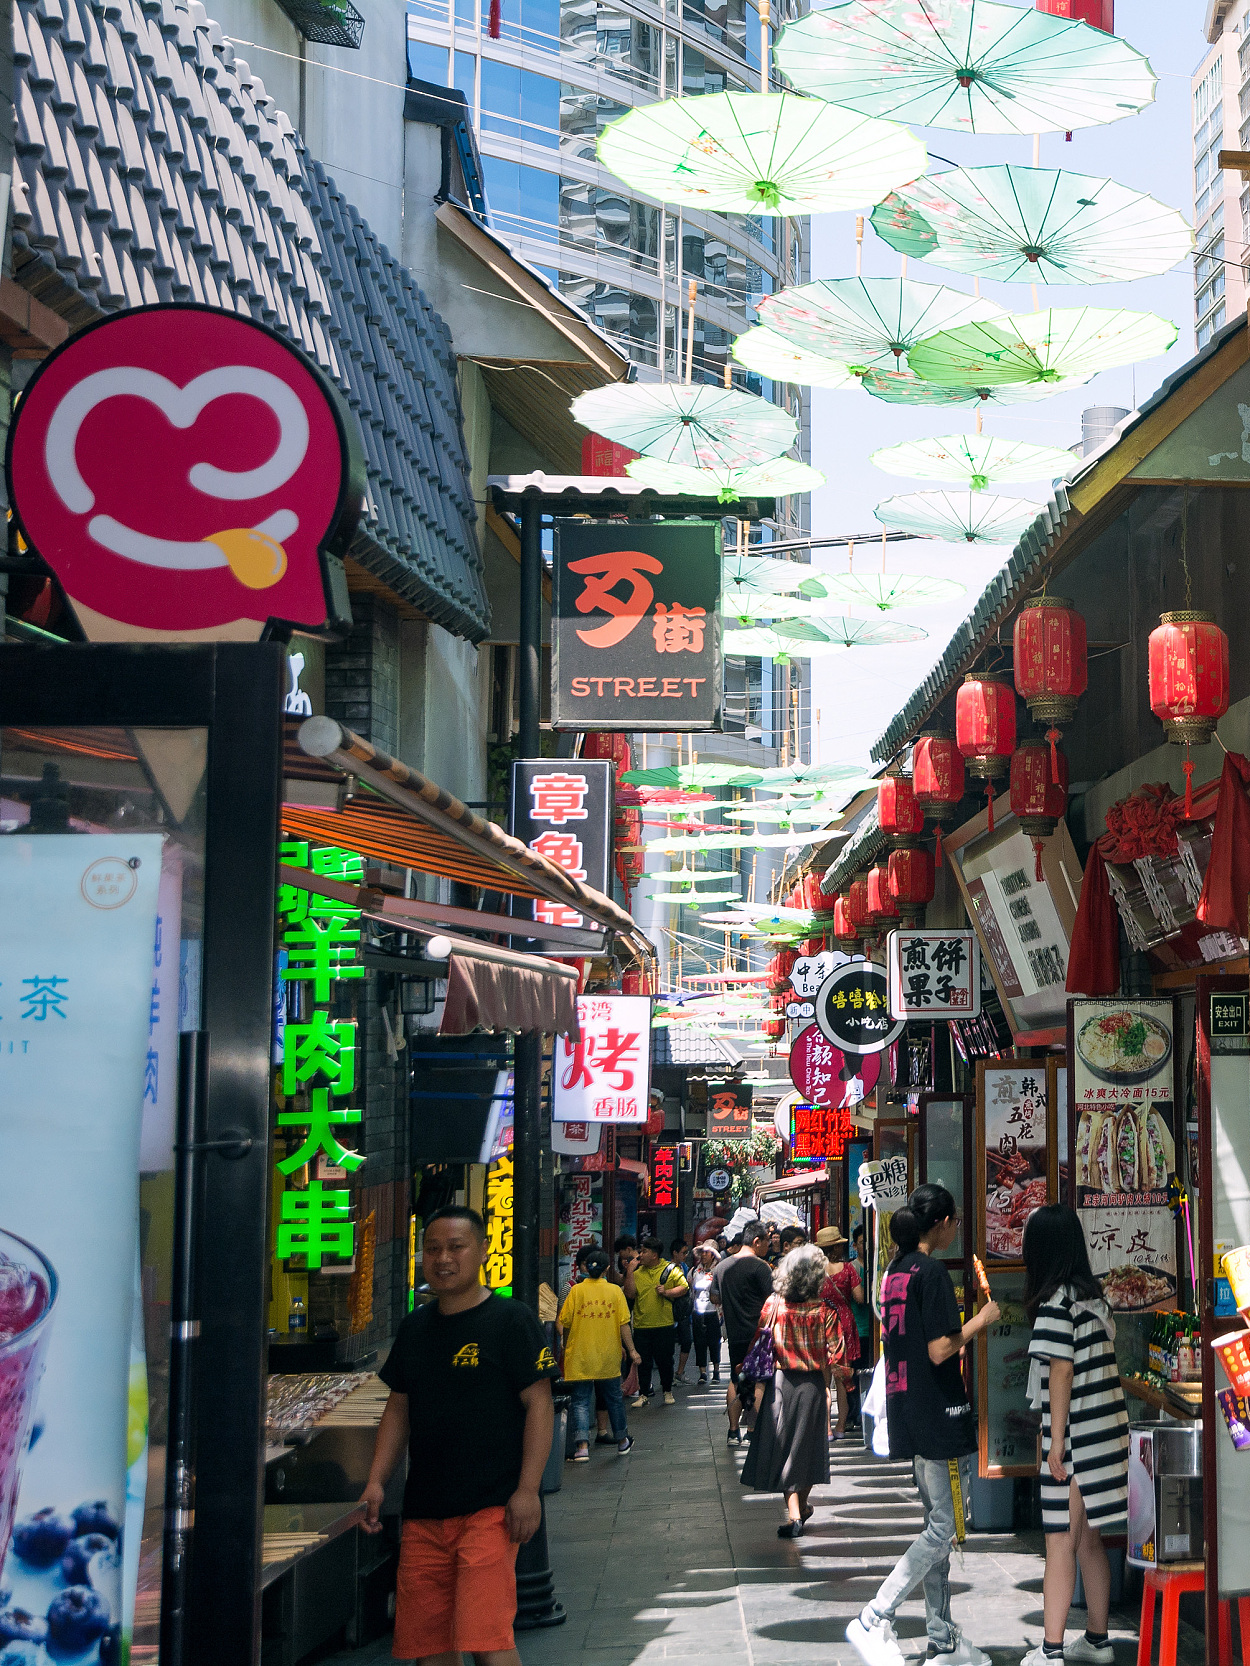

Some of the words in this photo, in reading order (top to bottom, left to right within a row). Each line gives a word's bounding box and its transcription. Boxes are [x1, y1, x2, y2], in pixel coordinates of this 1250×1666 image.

[571, 677, 706, 697] STREET
[902, 937, 968, 976] 煎饼
[0, 974, 70, 1021] 茶
[802, 983, 821, 993] Bea
[903, 972, 957, 1008] 果子
[1215, 1005, 1242, 1018] 安全出口
[845, 1016, 889, 1031] 小吃店
[562, 1027, 640, 1091] 烤
[1083, 1087, 1170, 1099] 冰爽大冷面15元
[594, 1097, 638, 1118] 香肠
[711, 1125, 749, 1134] STREET
[795, 1132, 853, 1158] 黑冰淇
[654, 1148, 675, 1207] 羊肉大串
[988, 1190, 1012, 1208] 15
[1090, 1223, 1157, 1254] 凉皮
[1219, 1286, 1231, 1300] 拉
